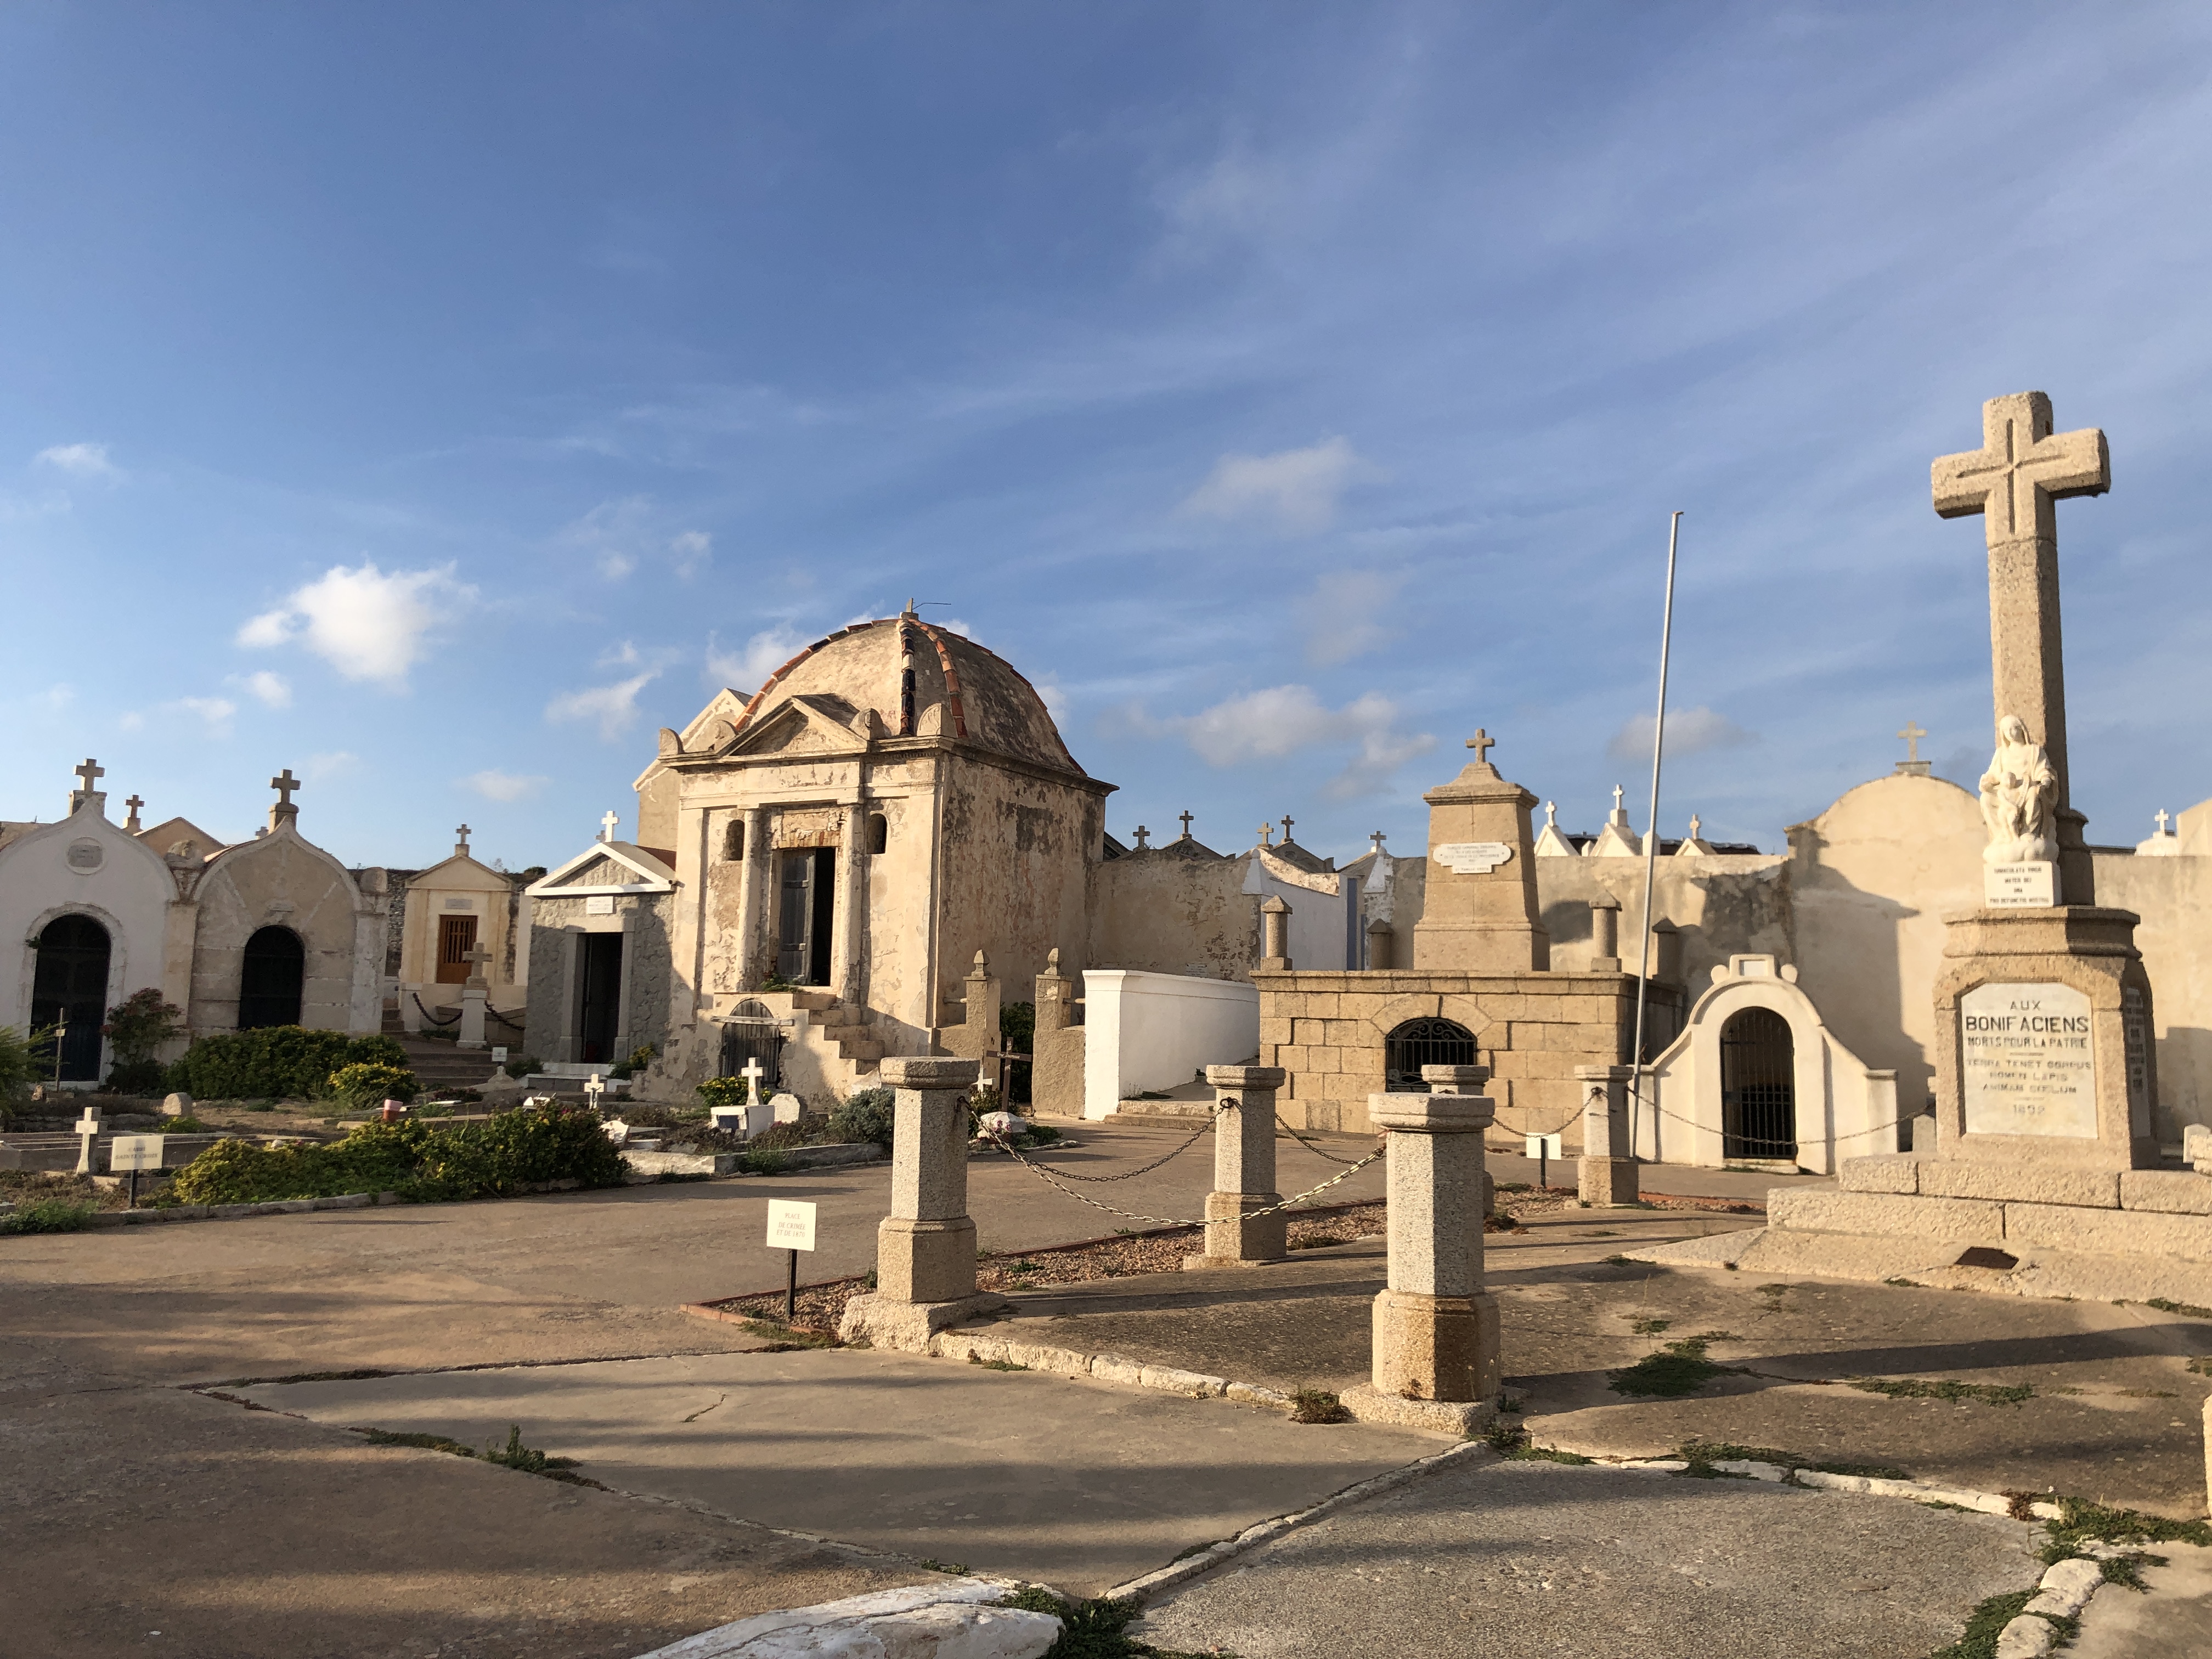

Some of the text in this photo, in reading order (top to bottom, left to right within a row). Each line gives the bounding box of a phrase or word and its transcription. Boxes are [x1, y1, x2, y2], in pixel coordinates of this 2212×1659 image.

[2010, 1000, 2041, 1011] AUX
[1966, 1015, 2089, 1034] BONIFACIENS
[1967, 1036, 2088, 1049] MORTS POUR LA PATRIE
[2006, 1059, 2042, 1069] TENET
